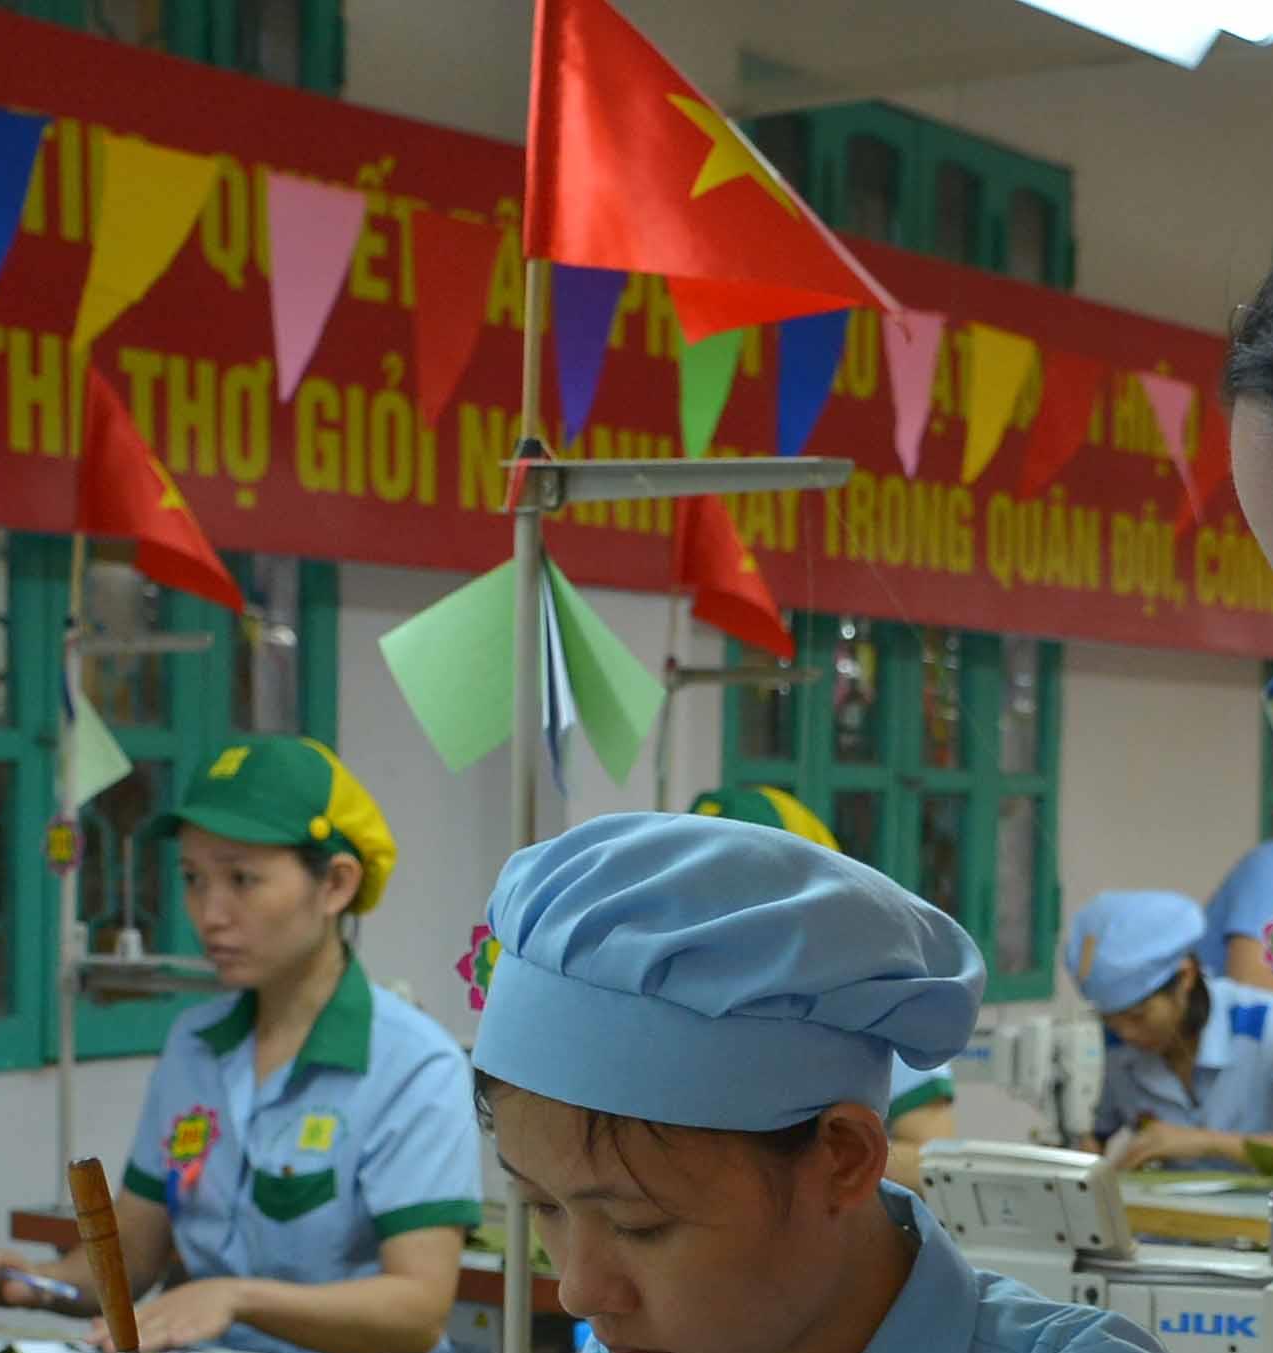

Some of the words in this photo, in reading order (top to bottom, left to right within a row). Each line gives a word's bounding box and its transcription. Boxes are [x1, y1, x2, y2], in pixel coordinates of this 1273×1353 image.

[119, 346, 273, 510] THỢ
[297, 353, 437, 507] GIỎI
[986, 486, 1102, 592] QUÂN
